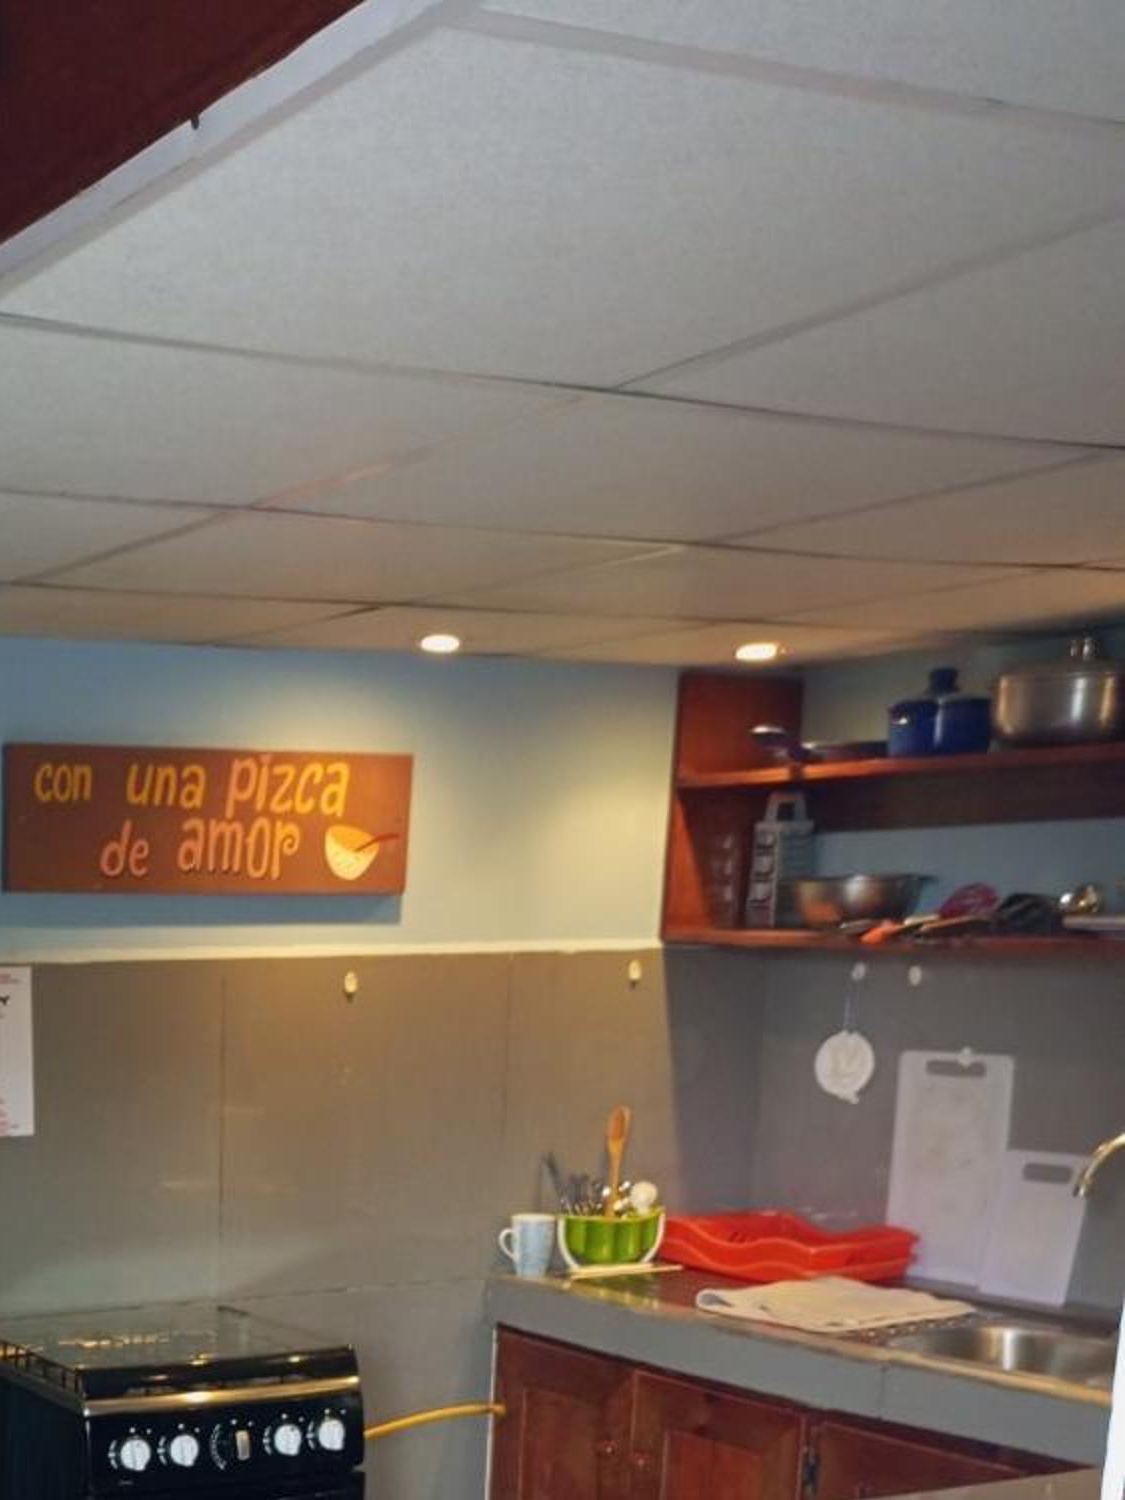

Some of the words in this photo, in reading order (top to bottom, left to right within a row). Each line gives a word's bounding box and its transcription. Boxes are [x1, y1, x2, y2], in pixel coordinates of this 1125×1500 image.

[33, 761, 93, 803] con
[125, 762, 206, 809] una
[225, 753, 350, 819] pizca
[98, 819, 151, 878] de
[176, 815, 301, 881] amor
